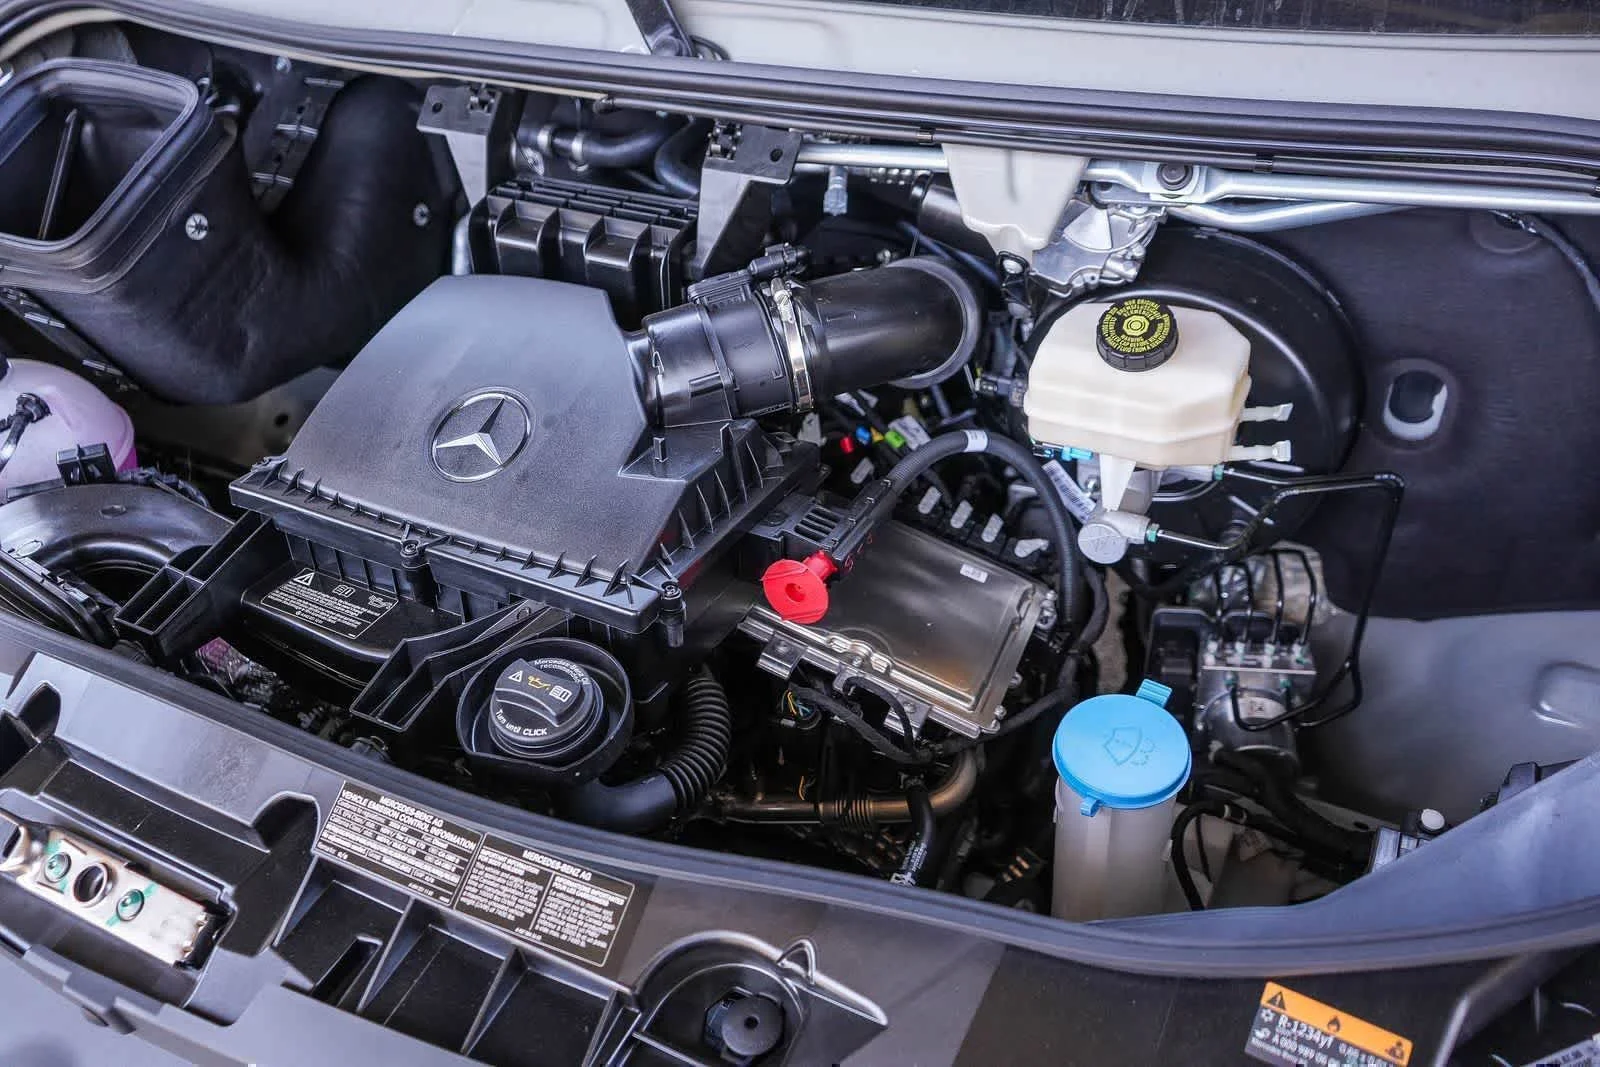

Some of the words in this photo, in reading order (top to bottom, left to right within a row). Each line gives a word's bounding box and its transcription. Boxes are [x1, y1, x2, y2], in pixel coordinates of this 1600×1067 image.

[534, 659, 585, 678] Mercedes-Benz
[495, 709, 507, 725] Turn
[505, 723, 522, 735] until
[522, 727, 548, 736] CLICK
[341, 791, 367, 805] VEHICLE
[367, 801, 399, 818] EMISSION
[398, 814, 430, 831] CONTROL
[429, 827, 475, 849] INFORMATION
[379, 796, 433, 823] MERCEDES-BENZ
[433, 818, 443, 827] AG
[522, 850, 579, 876] MERCEDES-BENZ
[579, 870, 591, 880] AG
[1277, 1014, 1334, 1049] R-1234yf
